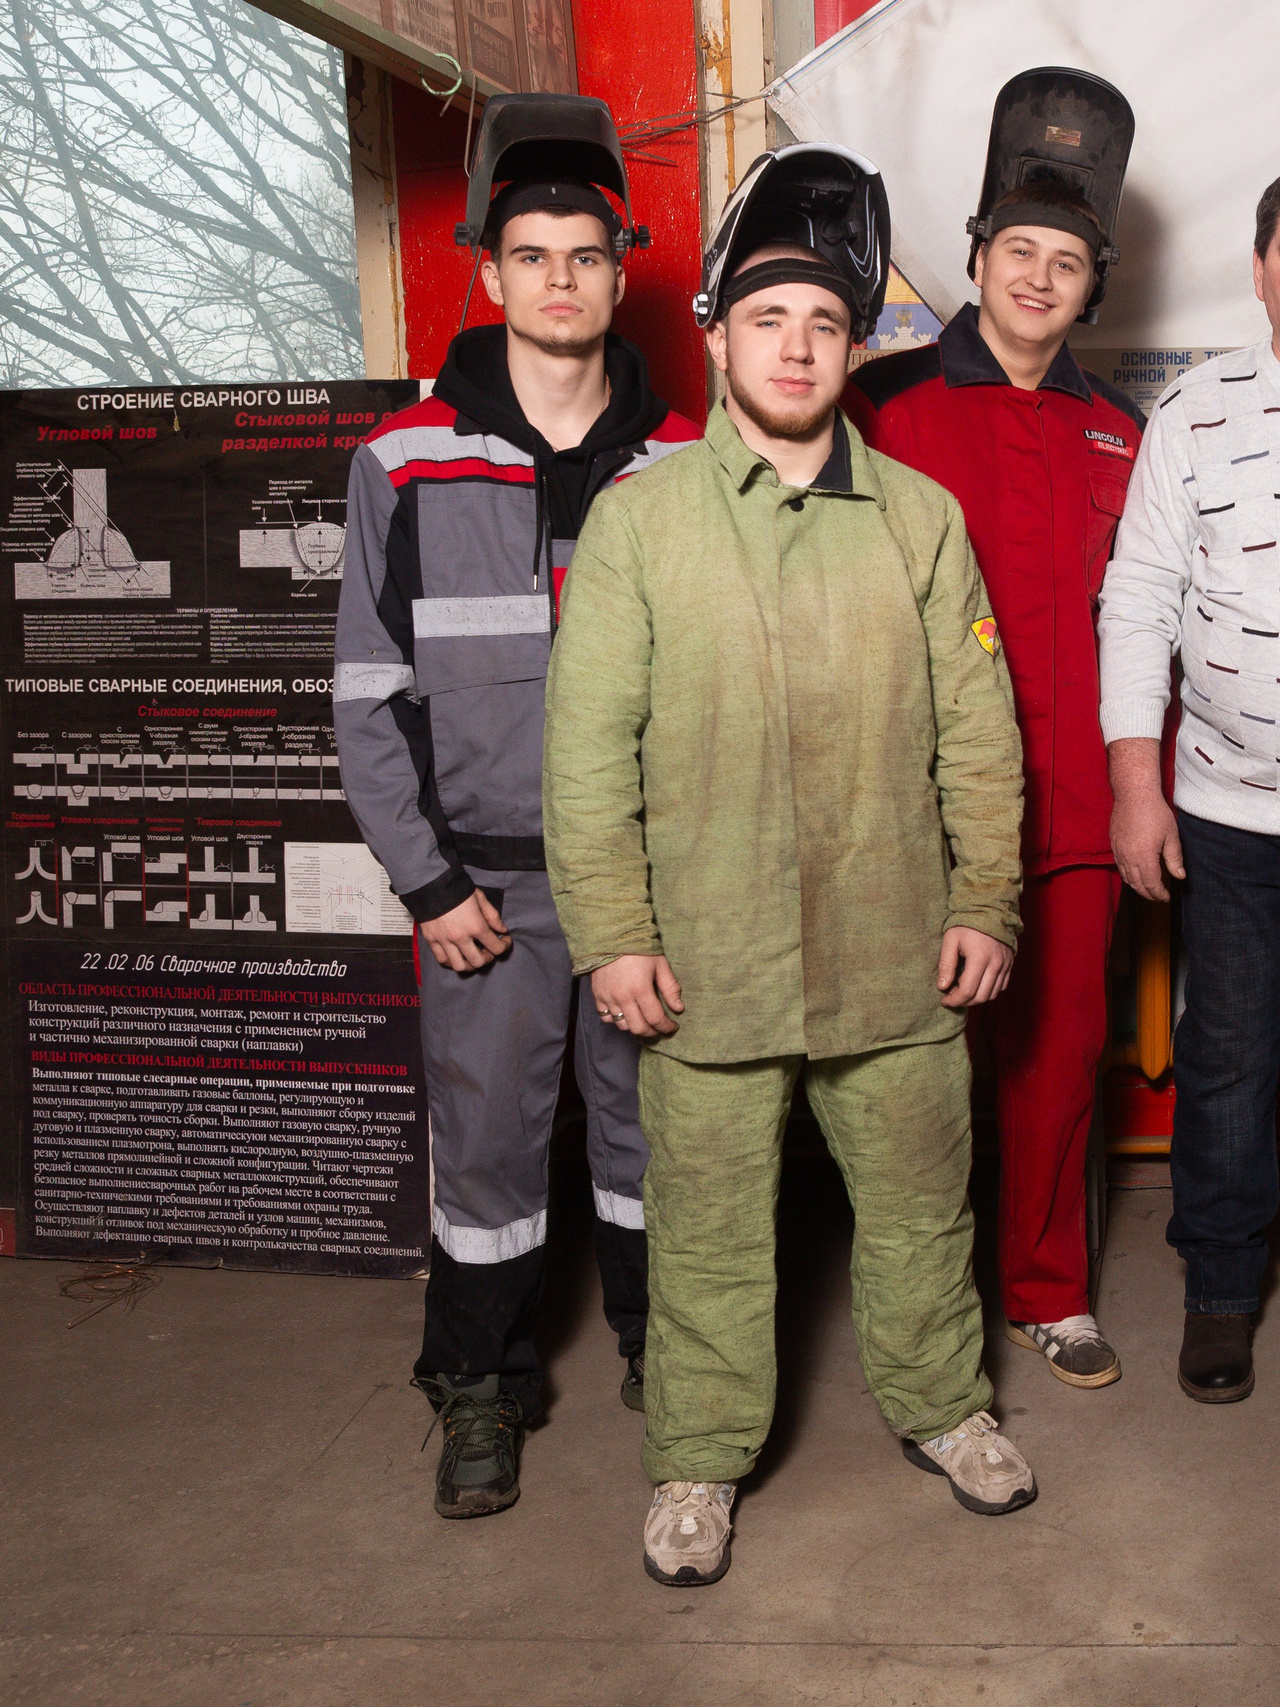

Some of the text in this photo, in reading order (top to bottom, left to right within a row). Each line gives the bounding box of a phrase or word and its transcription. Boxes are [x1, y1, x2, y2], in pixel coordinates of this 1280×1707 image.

[1121, 352, 1193, 366] ОСНОВНЫЕ
[1114, 367, 1166, 382] РУЧНОЙ
[76, 388, 331, 411] СТРОЕНИЕ СВАРНОГО ШВА
[235, 410, 330, 427] Стыковой
[336, 413, 376, 425] шов
[37, 424, 157, 442] Угловой шов
[222, 434, 328, 453] разделкой
[1085, 430, 1124, 446] LINCOLN
[4, 678, 84, 693] ТИПОВЫЕ
[88, 678, 168, 693] СВАРНЫЕ
[171, 678, 287, 695] СОЕДИНЕНИЯ,
[138, 706, 278, 718] Стыковое соединение
[277, 724, 319, 732] Двусторонняя
[196, 818, 234, 826] Тавровое
[80, 952, 347, 979] 22 .02 .06 Сварочное производство
[18, 982, 76, 995] ОБЛАСТЬ
[77, 984, 216, 999] ПРОФЕССИОНАЛЬНОЙ
[217, 989, 318, 1003] ДЕЯТЕЛЬНОСТИ
[28, 1000, 386, 1024] Изготовление, реконструкция, монтаж, ремонт строительство
[28, 1017, 366, 1040] конструкций различного назначения применением ручной
[39, 1033, 304, 1053] частично механизированной сварки (наплавки)
[31, 1051, 408, 1075] ВИДЫ ПРОФЕССИОНАЛЬНОЙ ДЕЯТЕЛЬНОСТИ ВЫПУСКНИКОВ
[32, 1067, 415, 1093] Выполняют типовые слесарные операции, применяемые при подготовке
[79, 1085, 356, 1107] сварке, подготавливать газовые баллоны, регулирующую
[32, 1097, 416, 1122] коммуникационную аппаратуру сварки резки, выполняют сборку изделий
[52, 1110, 401, 1136] сварку, проверять точность сборки. Выполняют газовую сварку, ручную
[32, 1123, 399, 1150] дуговую плазменную сварку, автоматическуюи механизированную сварку
[33, 1136, 414, 1163] использованием плазмотрона, выполнять кислородную, воздушно-плазменную
[33, 1149, 394, 1176] резку металлов прямолинейной сложной конфигурации. Читают чертежи
[33, 1162, 399, 1188] средней сложности сложных сварных металлоконструкций, обеспечивают
[33, 1173, 388, 1201] безопасное выполнениесварочных работ рабочем месте соответствии
[33, 1189, 372, 1216] санитарно-техническими требованиями требованиями охраны труда.
[35, 1225, 425, 1257] Выполняют дефектацию сварных швов контролькачества сварных соединений.
